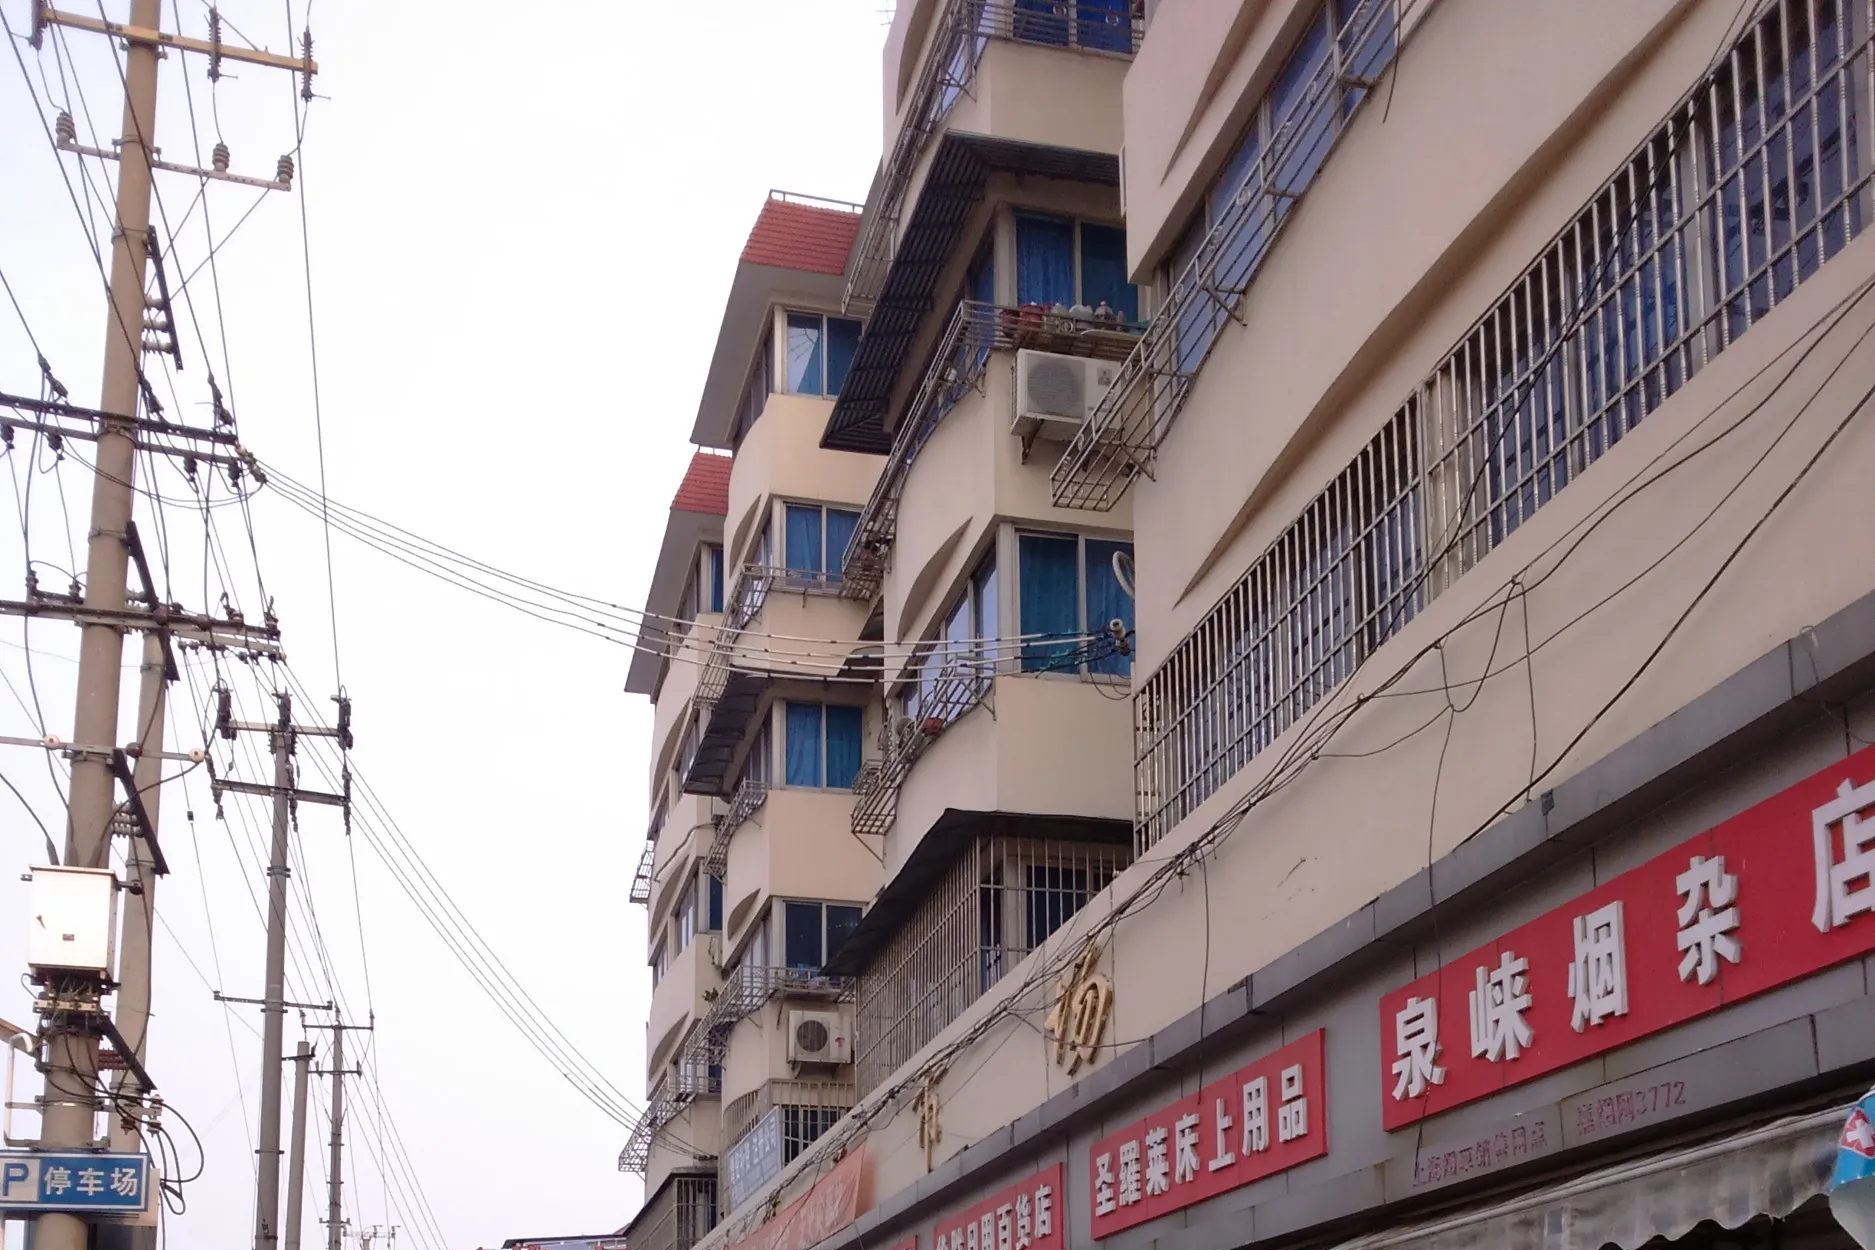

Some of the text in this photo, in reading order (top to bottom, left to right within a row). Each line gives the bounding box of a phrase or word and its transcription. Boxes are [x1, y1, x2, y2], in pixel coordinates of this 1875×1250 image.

[1391, 778, 1875, 1101] 泉崃烟杂店
[2, 1163, 30, 1196] P
[44, 1166, 139, 1197] 停车场
